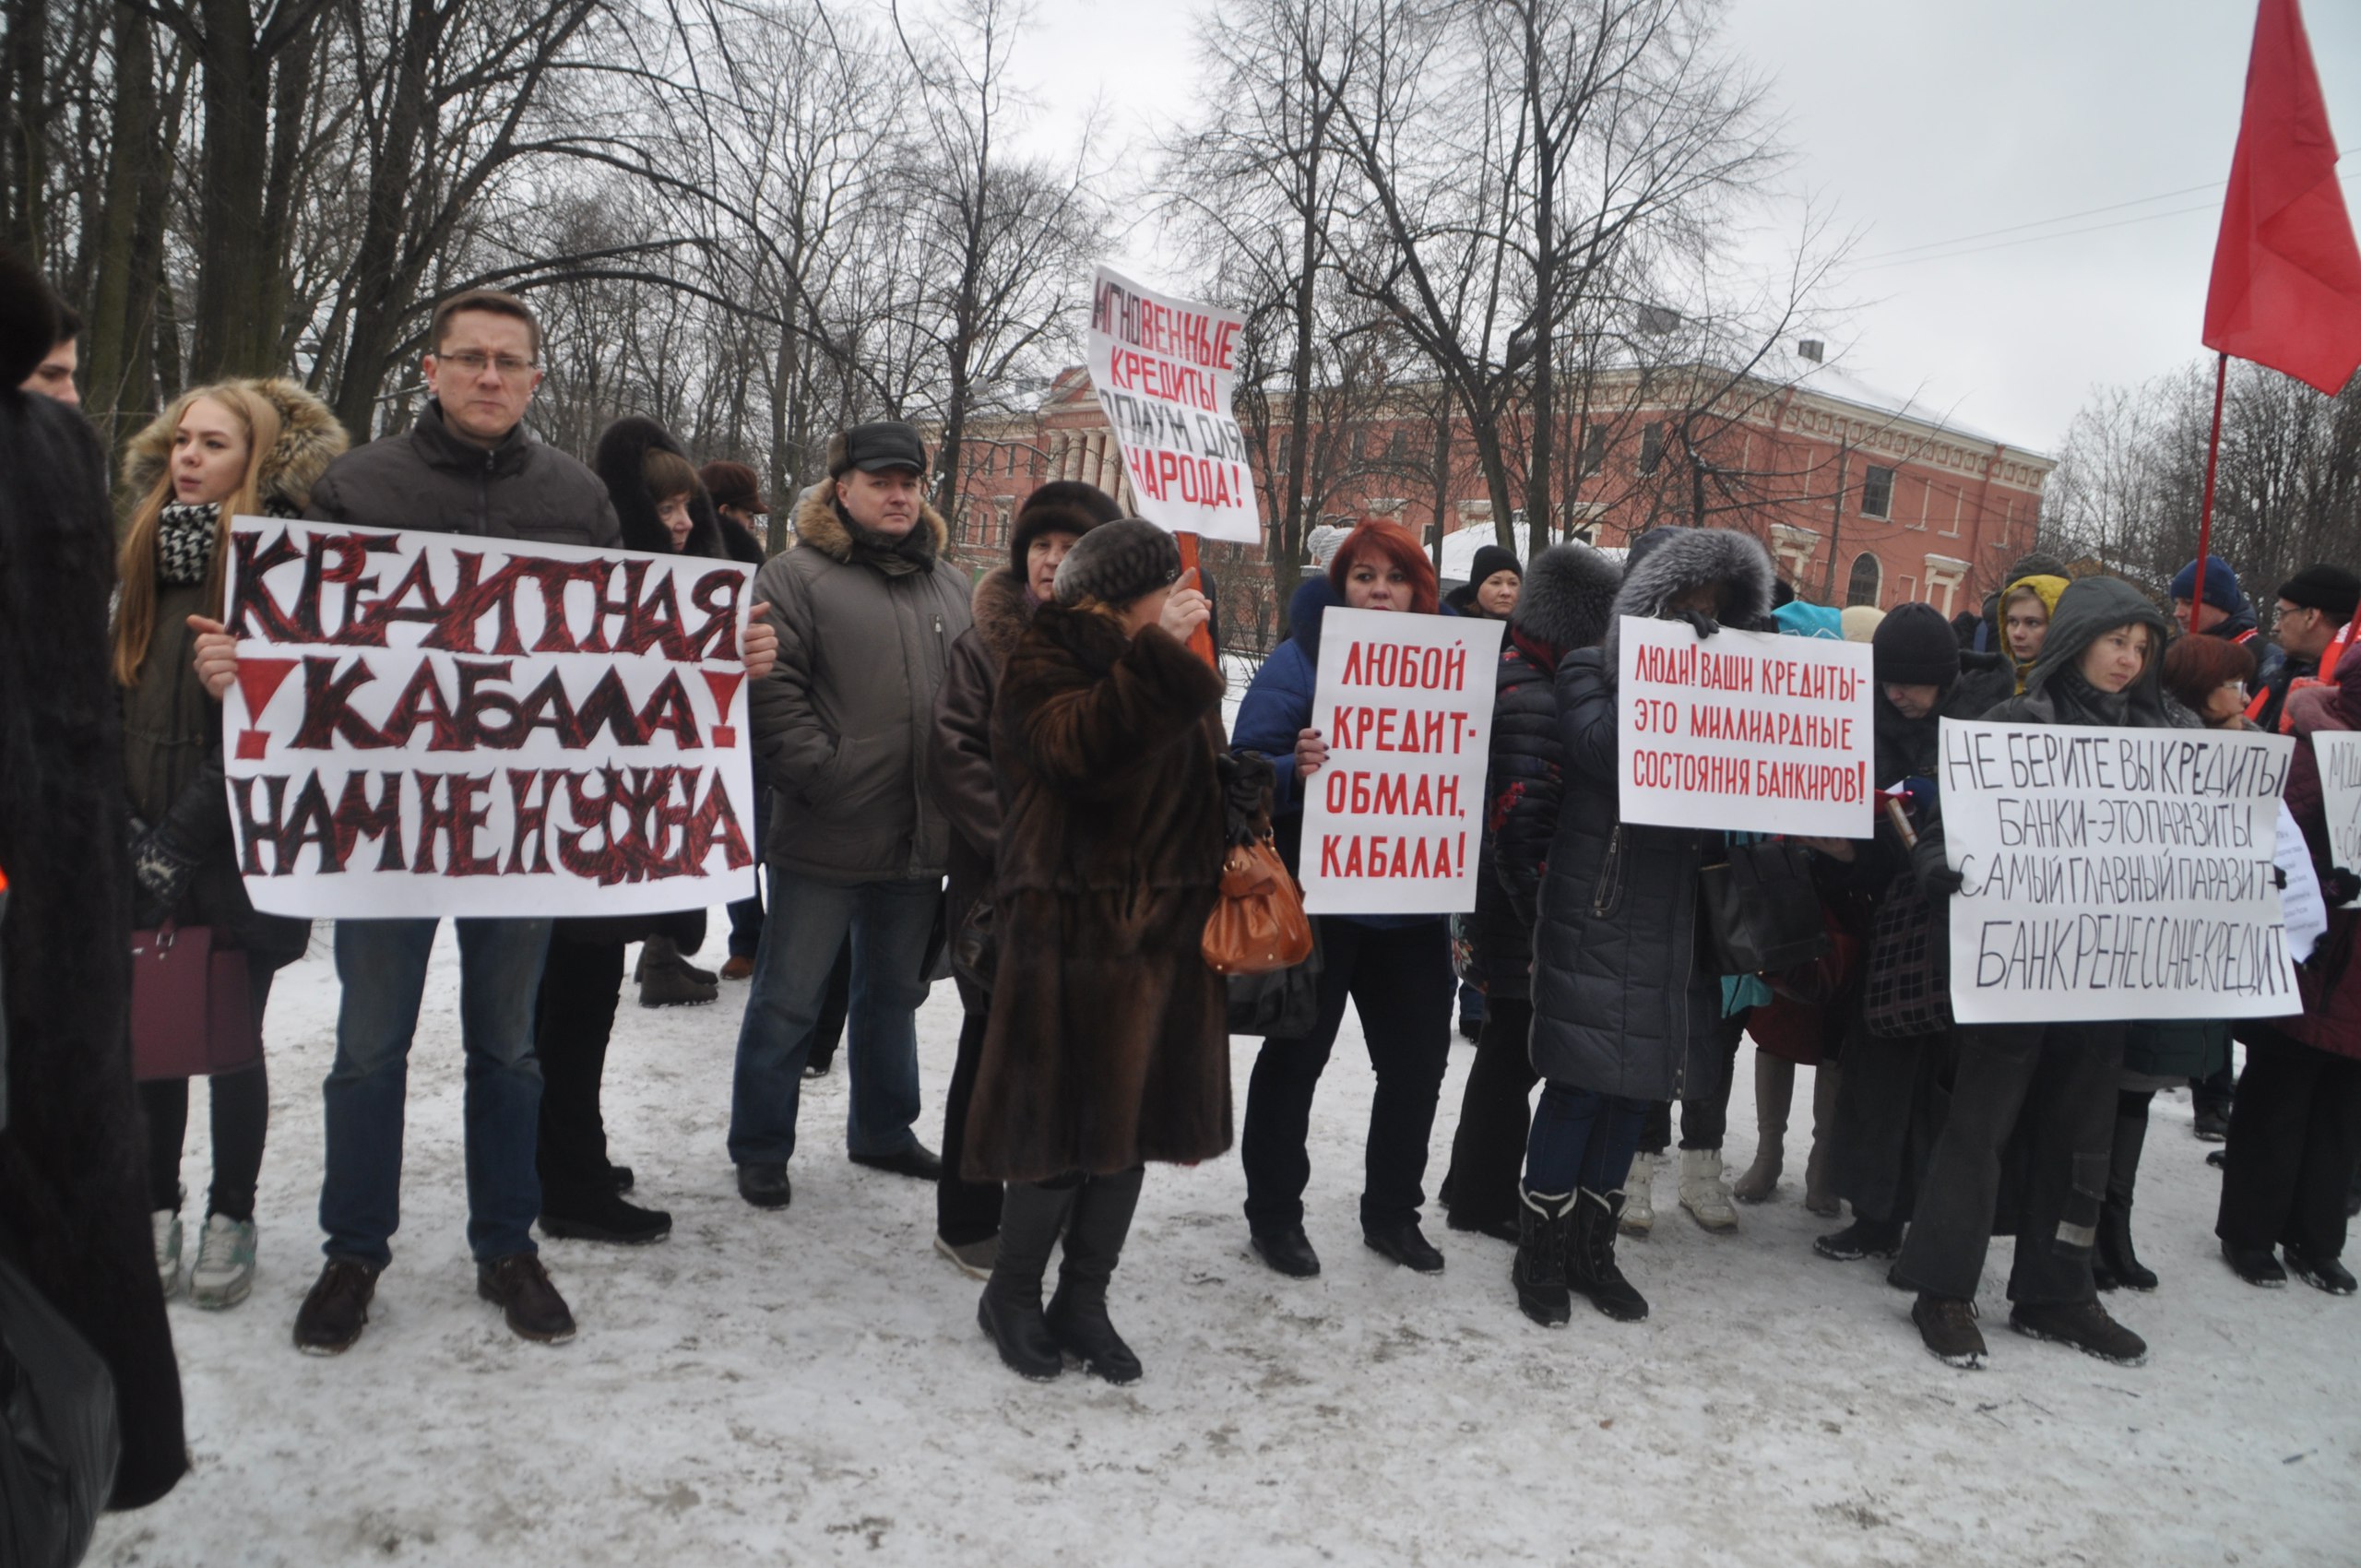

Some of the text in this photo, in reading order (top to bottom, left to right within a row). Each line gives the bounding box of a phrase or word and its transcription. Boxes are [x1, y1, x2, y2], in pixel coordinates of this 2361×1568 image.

[1092, 278, 1241, 371] МГНОВЕННЫЕ
[1110, 345, 1218, 414] КРЕДИТЫ
[1195, 412, 1246, 464] ДЛЯ
[1124, 444, 1243, 512] НАРОДА!
[225, 524, 746, 663] КРЕДИТНАЯ
[1341, 638, 1466, 691] ЛЮБОЙ
[1634, 643, 1867, 703] ЛЮДИ! ВАШИ КРЕДИТЫ-
[1634, 697, 1854, 750] ЭТО МИЛЛИАРДНЫЕ
[1633, 749, 1866, 805] СОСТОЯНИЯ БАНКИРОВ!
[1945, 729, 2288, 798] НЕ БЕРИТЕ ВЫ КРЕДИТЫ
[228, 756, 753, 887] НАМ НЕ НУЖНА
[1325, 769, 1465, 821] ОБМАН,
[1320, 831, 1465, 878] КАБАЛА!
[1958, 852, 2063, 904] САМЫЙ
[2067, 848, 2175, 904] ГЛАВНЫЙ
[1975, 919, 2069, 991] БАНК
